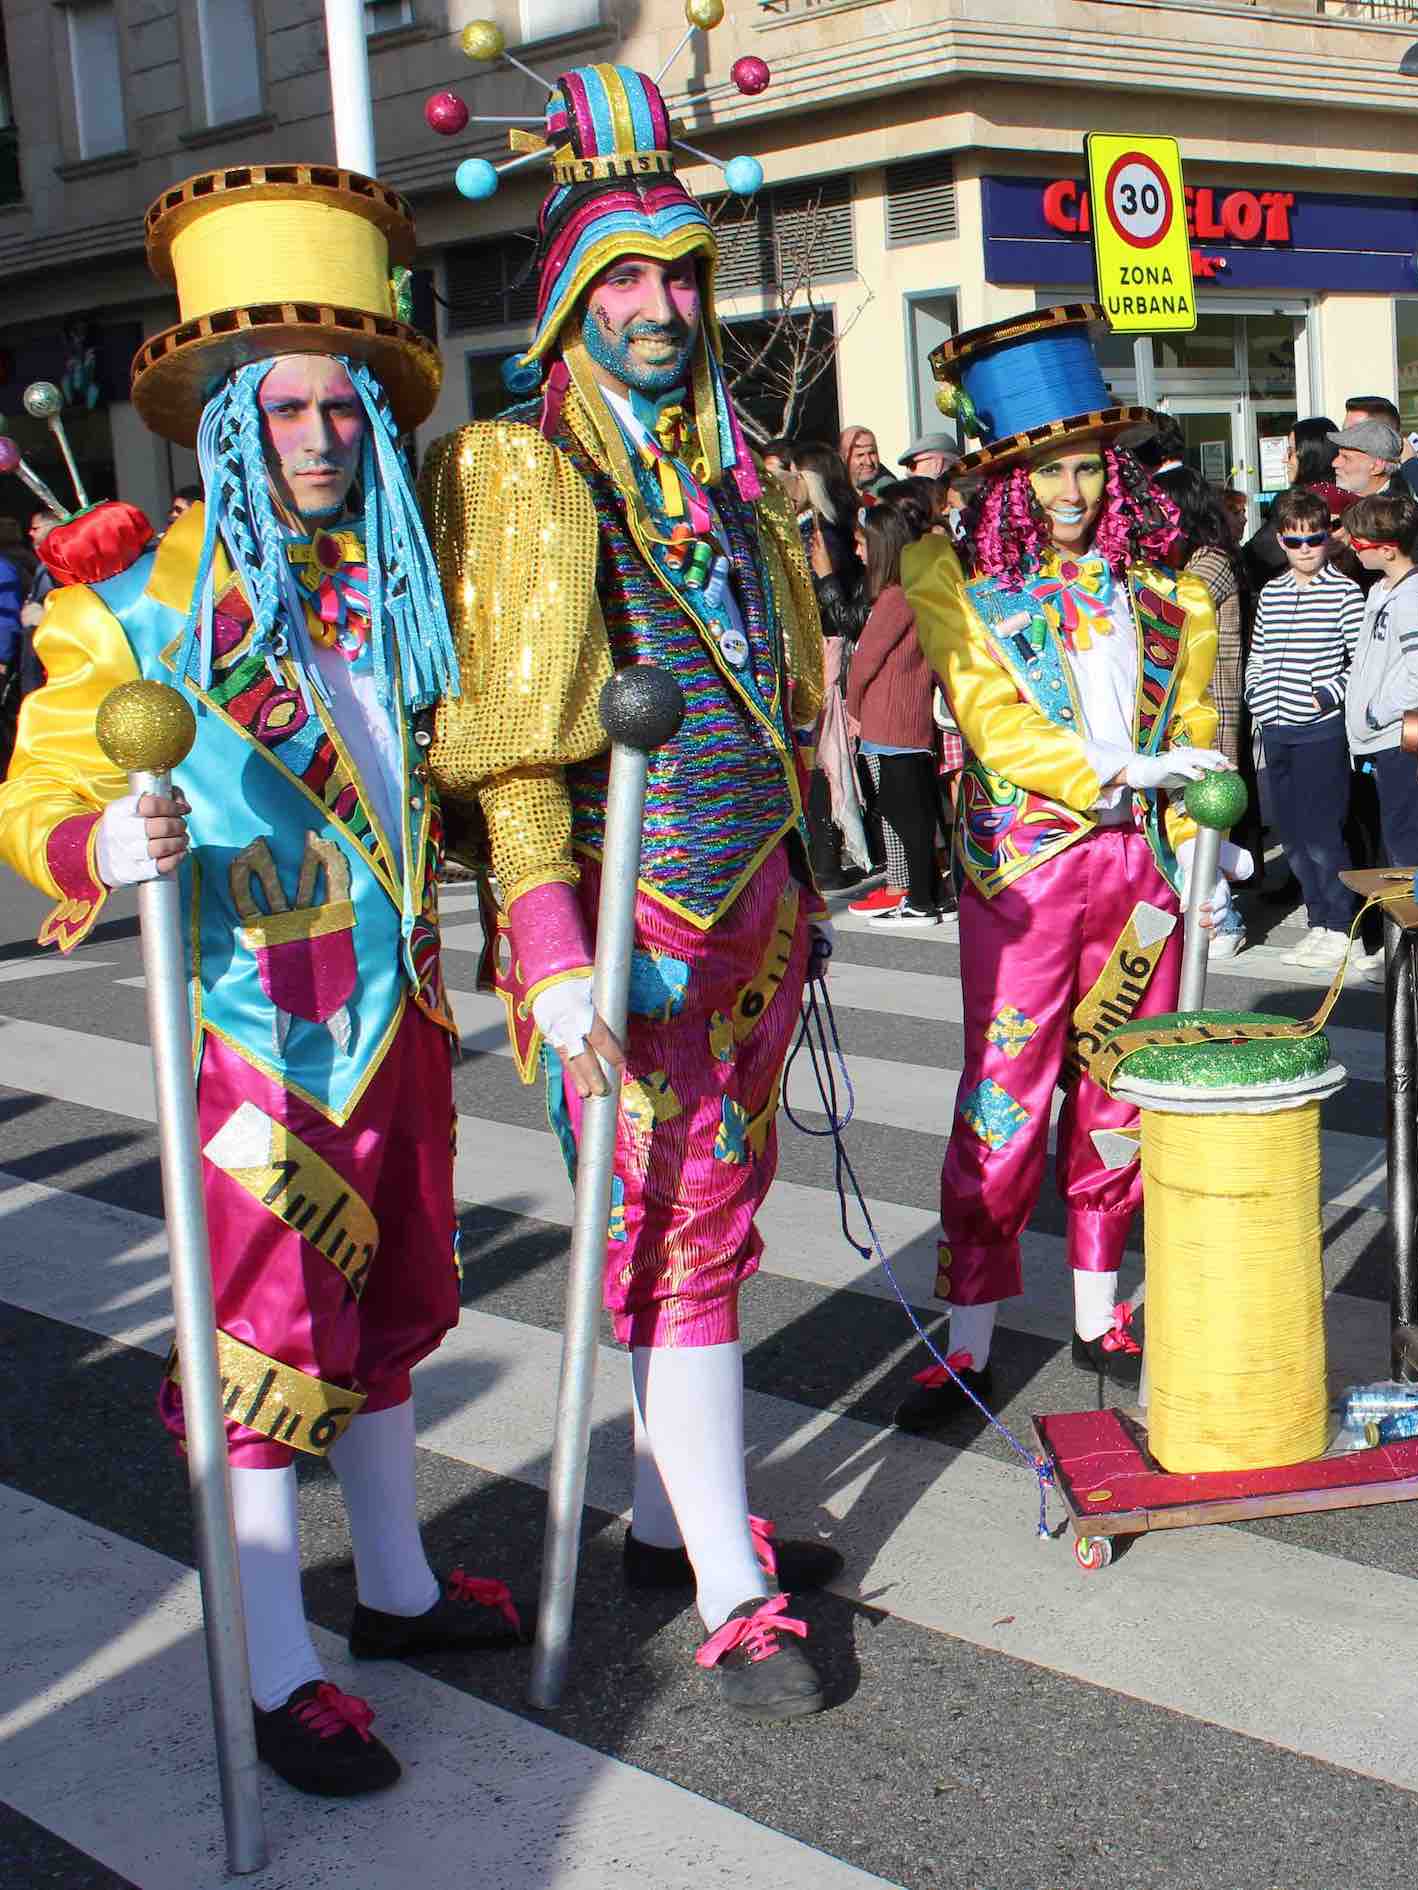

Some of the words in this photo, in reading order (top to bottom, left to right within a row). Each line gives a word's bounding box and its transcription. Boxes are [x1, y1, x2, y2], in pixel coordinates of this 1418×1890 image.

[1119, 184, 1160, 217] 30
[1119, 266, 1174, 286] ZONA
[1108, 295, 1189, 315] URBANA
